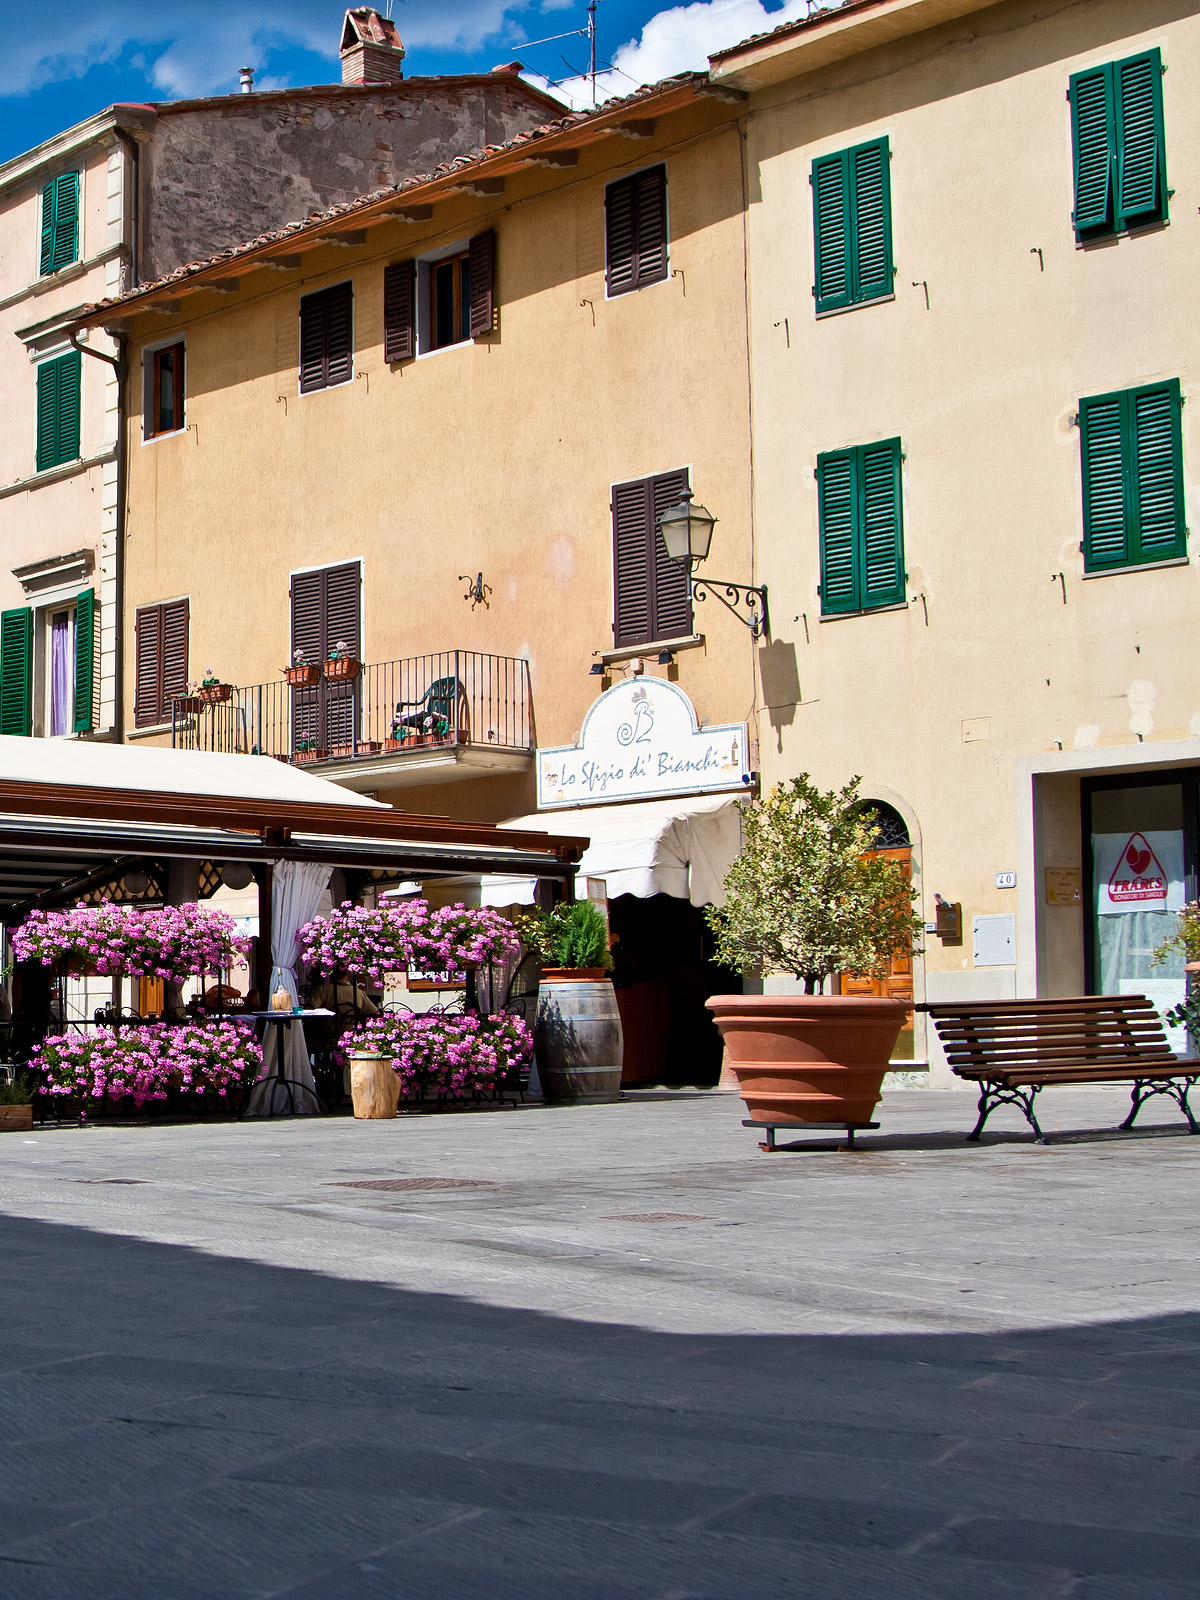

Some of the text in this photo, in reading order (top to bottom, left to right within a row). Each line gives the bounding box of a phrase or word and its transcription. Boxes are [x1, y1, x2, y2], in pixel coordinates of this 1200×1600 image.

[561, 763, 576, 786] Lo
[581, 760, 624, 792] Sfizio
[657, 745, 720, 777] Bianchi
[1114, 893, 1139, 901] DONATORI
